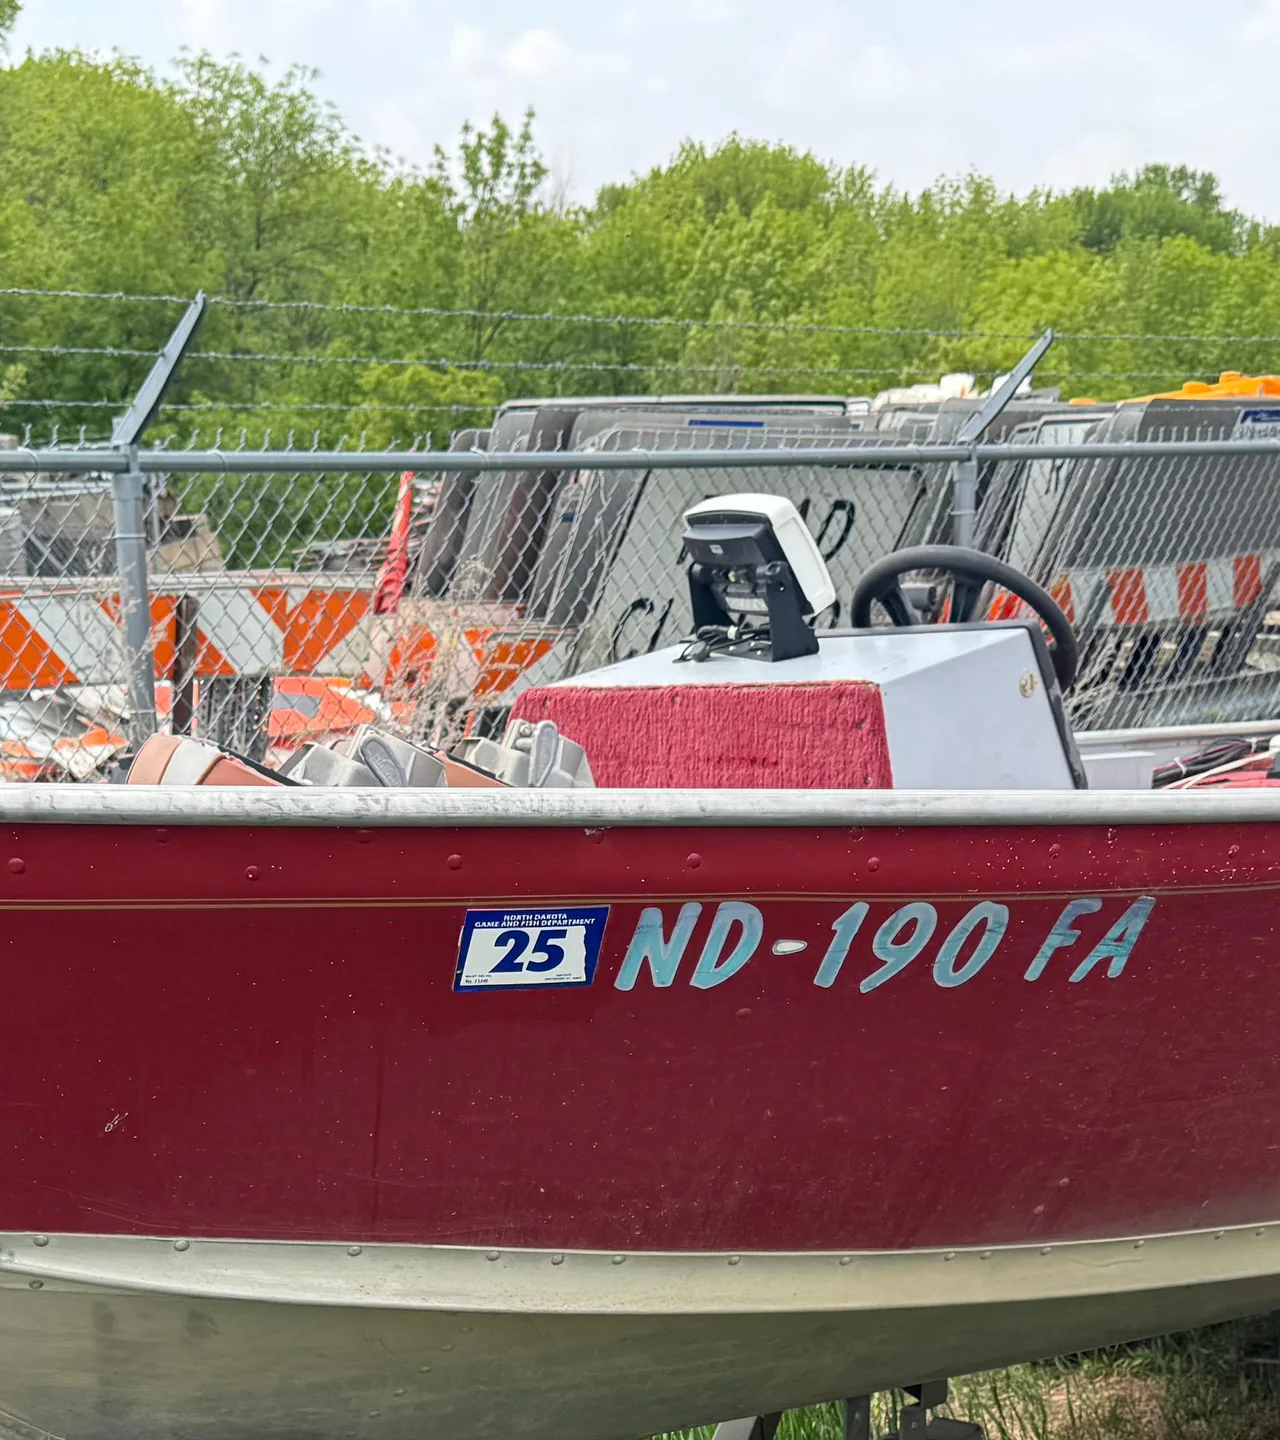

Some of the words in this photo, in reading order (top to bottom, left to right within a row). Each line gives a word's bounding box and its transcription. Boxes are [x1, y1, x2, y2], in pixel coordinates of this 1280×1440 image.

[541, 918, 596, 927] DEPARTMENT
[1022, 896, 1157, 983] FA
[488, 929, 568, 974] 25
